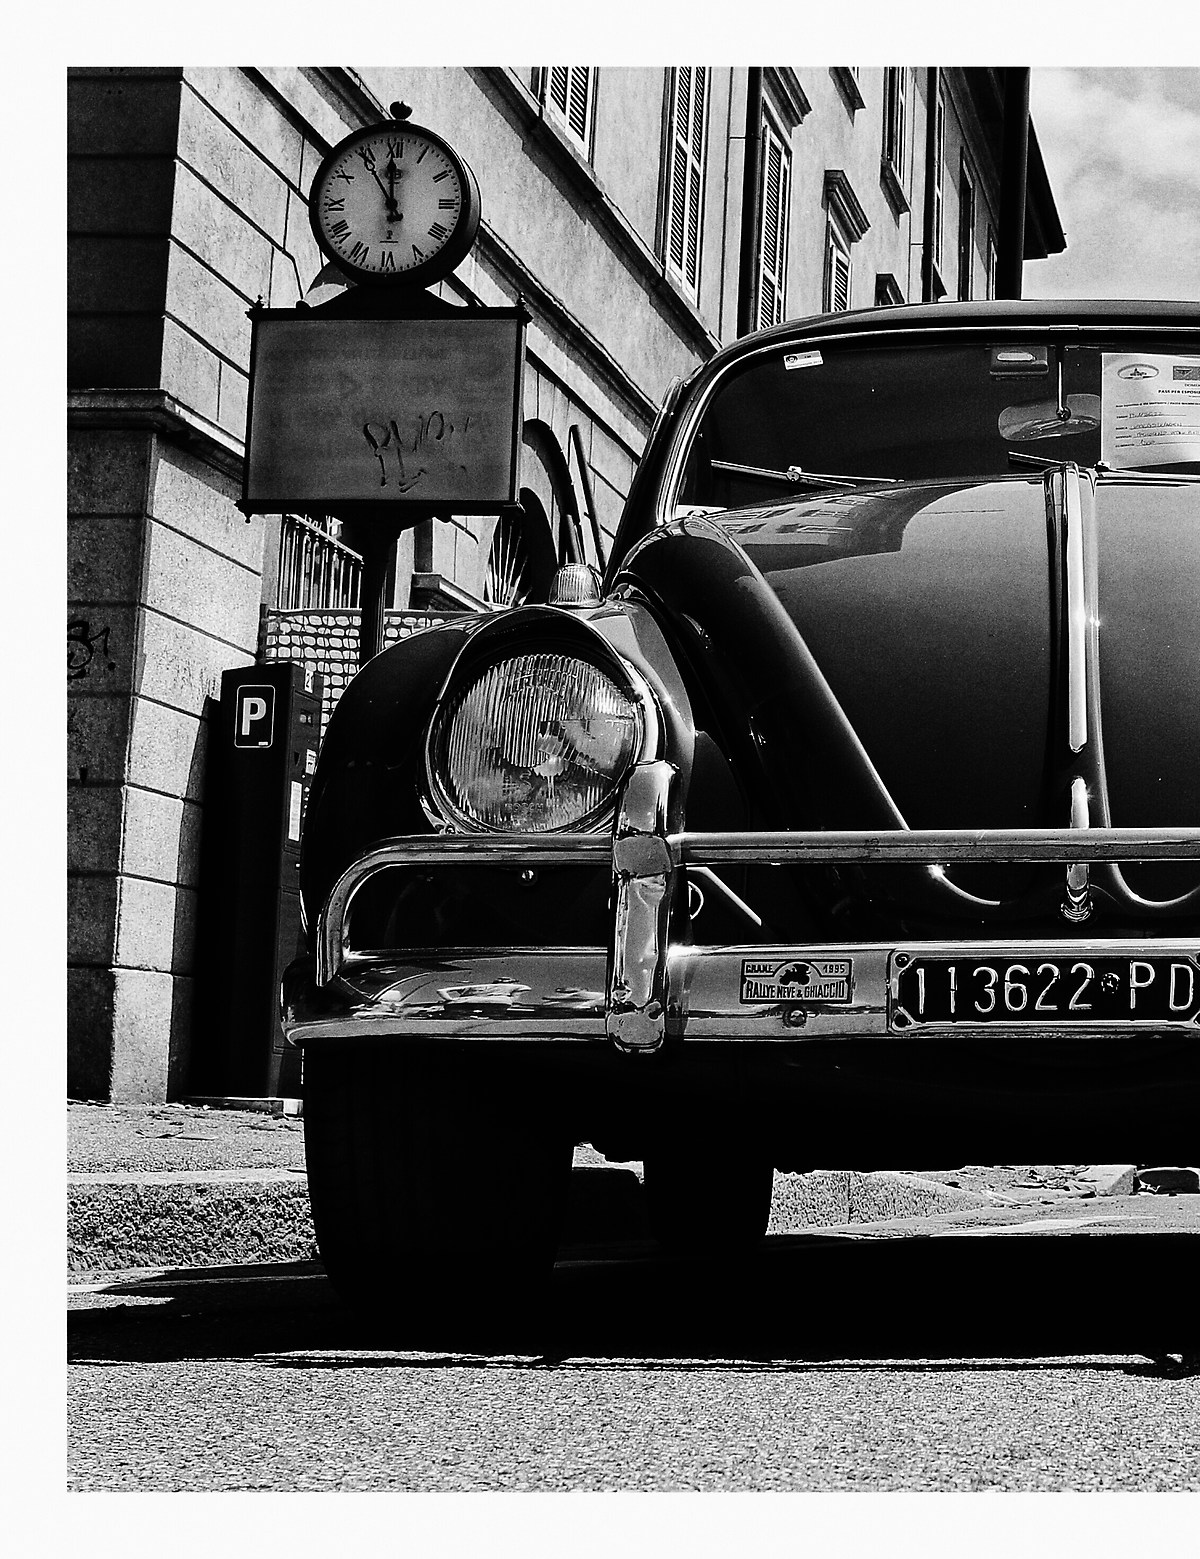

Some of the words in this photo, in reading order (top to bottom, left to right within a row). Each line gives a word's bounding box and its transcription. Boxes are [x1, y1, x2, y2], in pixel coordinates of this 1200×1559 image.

[386, 139, 404, 158] XII
[417, 146, 430, 164] I
[337, 169, 355, 185] X
[432, 170, 450, 183] II
[328, 198, 345, 211] IX
[438, 199, 456, 209] III
[330, 219, 352, 244] VIII
[427, 222, 447, 241] IIII
[348, 241, 370, 266] VII
[382, 251, 395, 268] VI
[412, 244, 424, 261] V
[241, 697, 267, 735] P
[823, 964, 845, 973] 1995
[746, 980, 776, 998] RALLYE
[777, 985, 796, 998] NEVE
[796, 989, 803, 998] &
[804, 980, 845, 998] GHIACCIO
[915, 961, 1095, 1015] 113622
[1129, 960, 1194, 1011] PD
